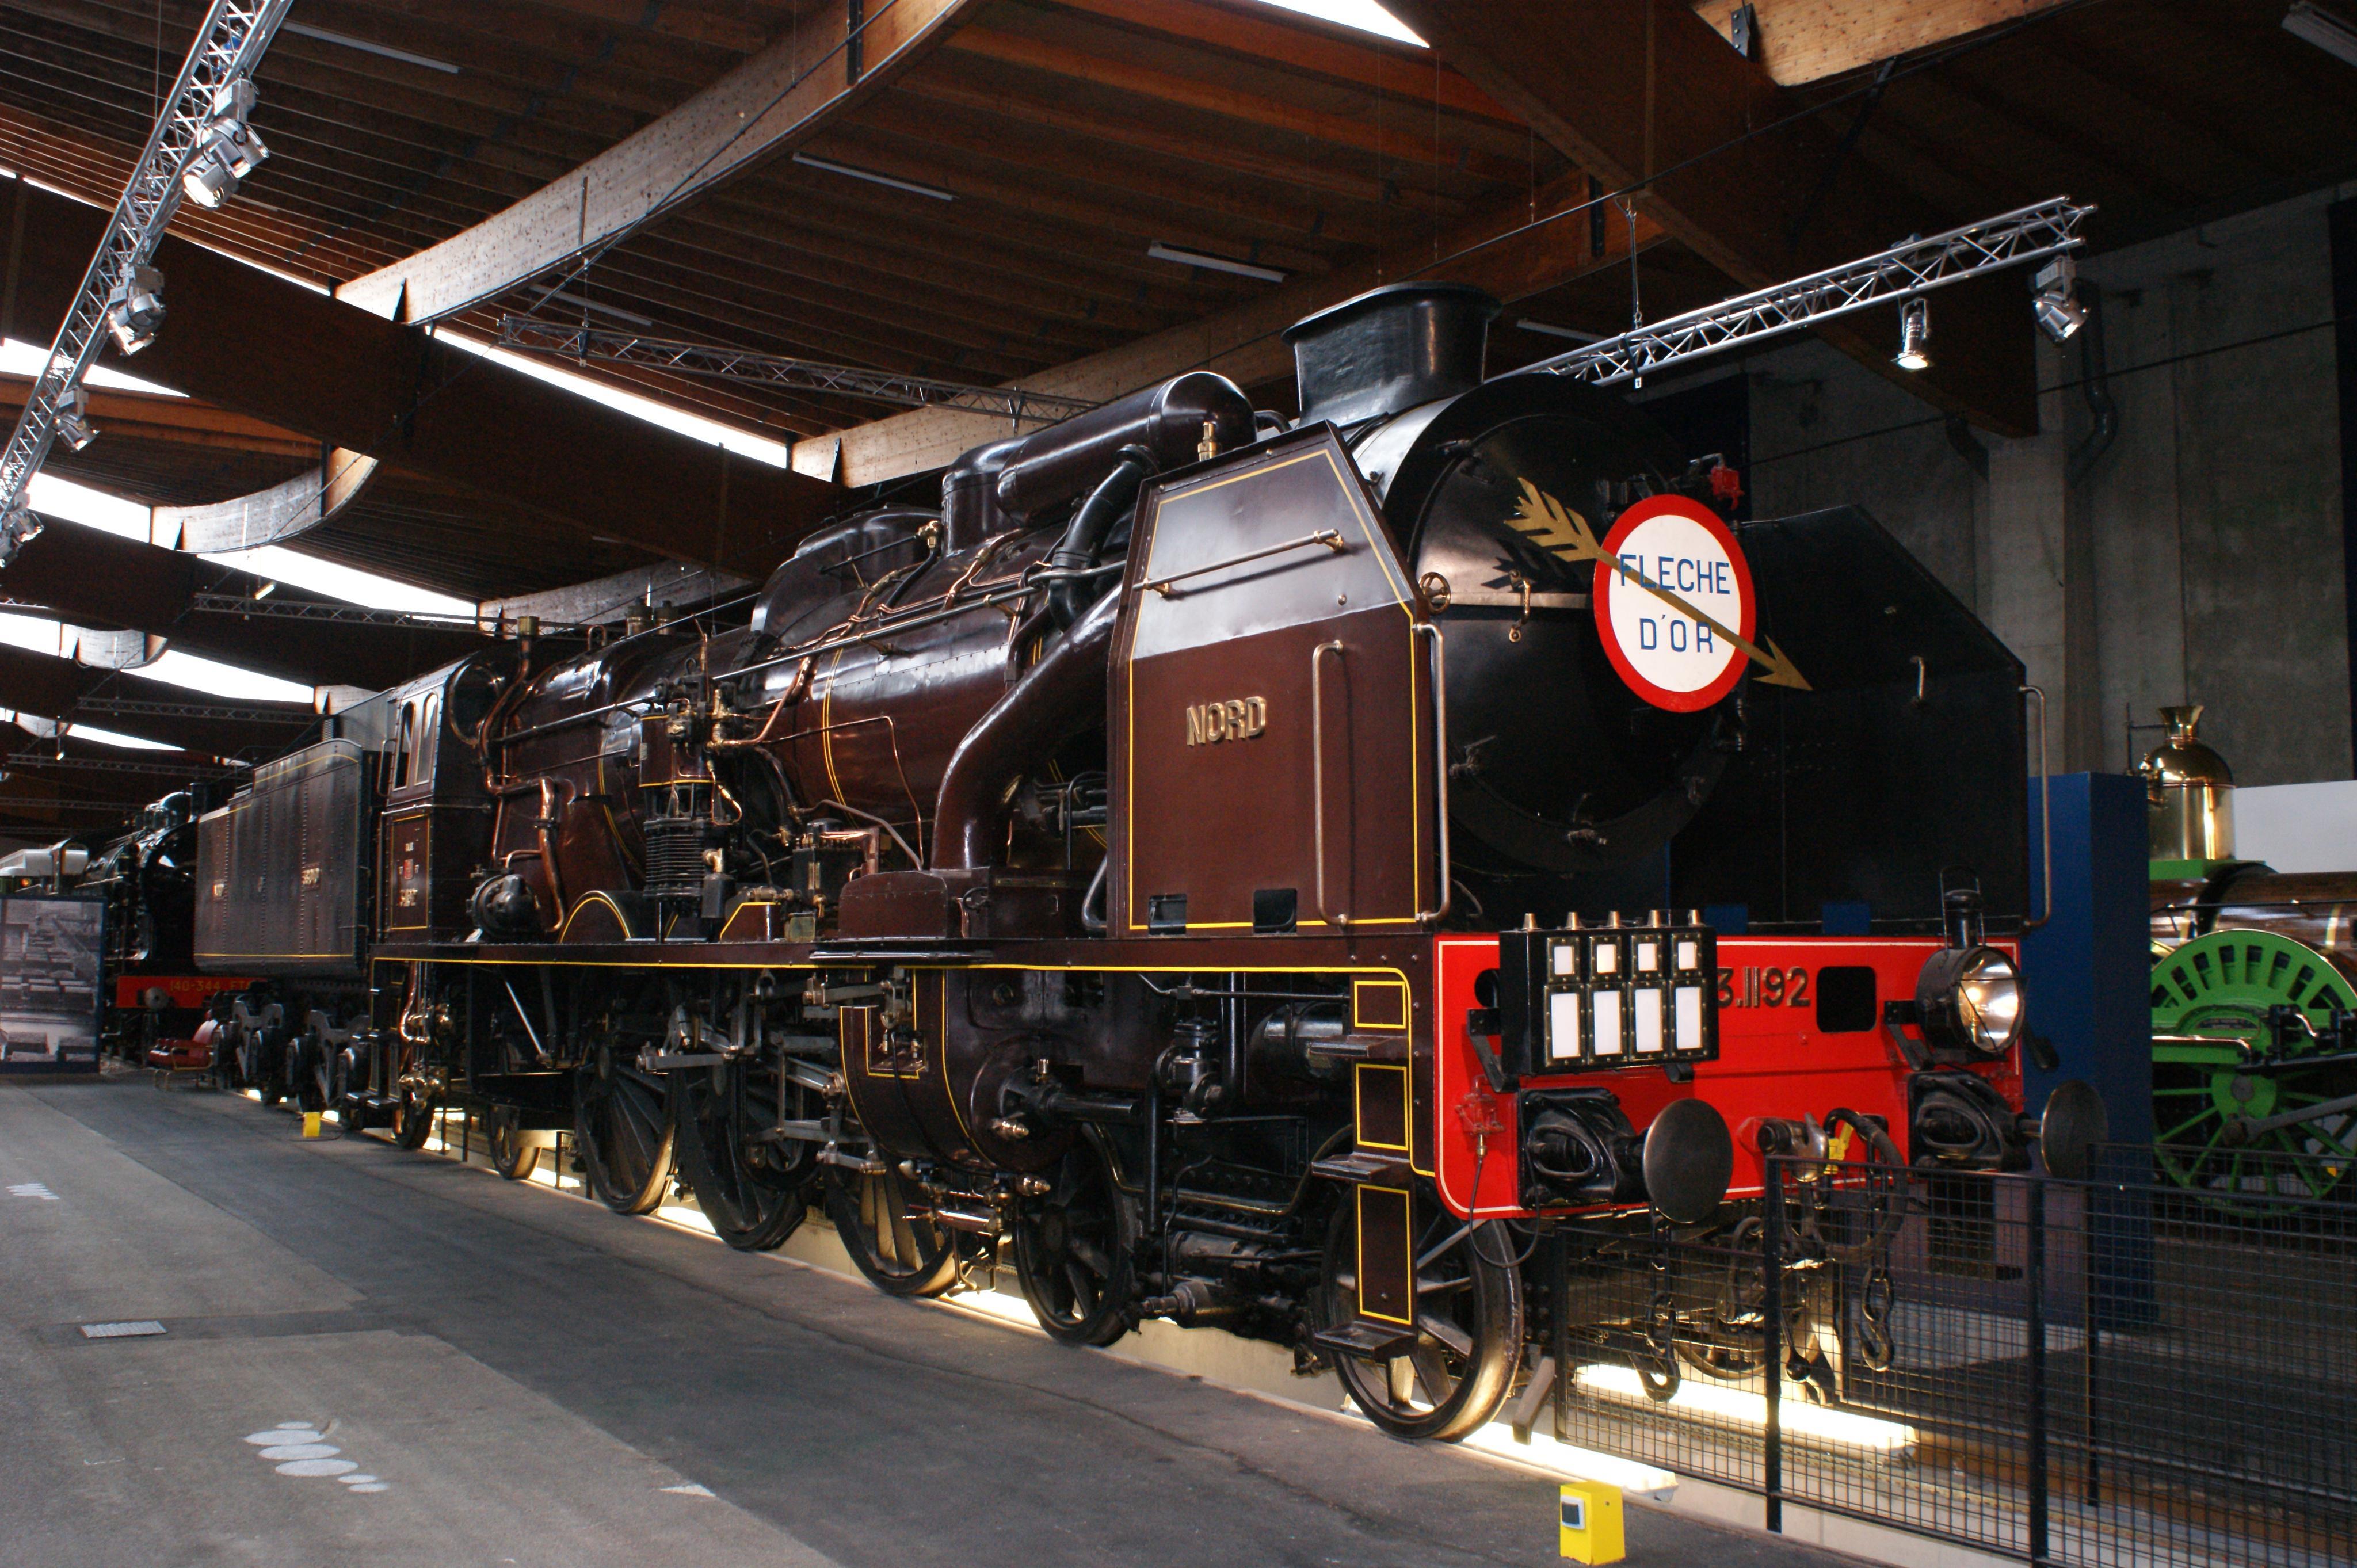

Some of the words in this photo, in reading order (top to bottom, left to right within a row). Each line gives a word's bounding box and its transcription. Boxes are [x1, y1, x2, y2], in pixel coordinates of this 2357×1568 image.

[1619, 554, 1731, 595] FLECHE
[1639, 614, 1713, 654] D'OR
[1186, 696, 1266, 746] NORD
